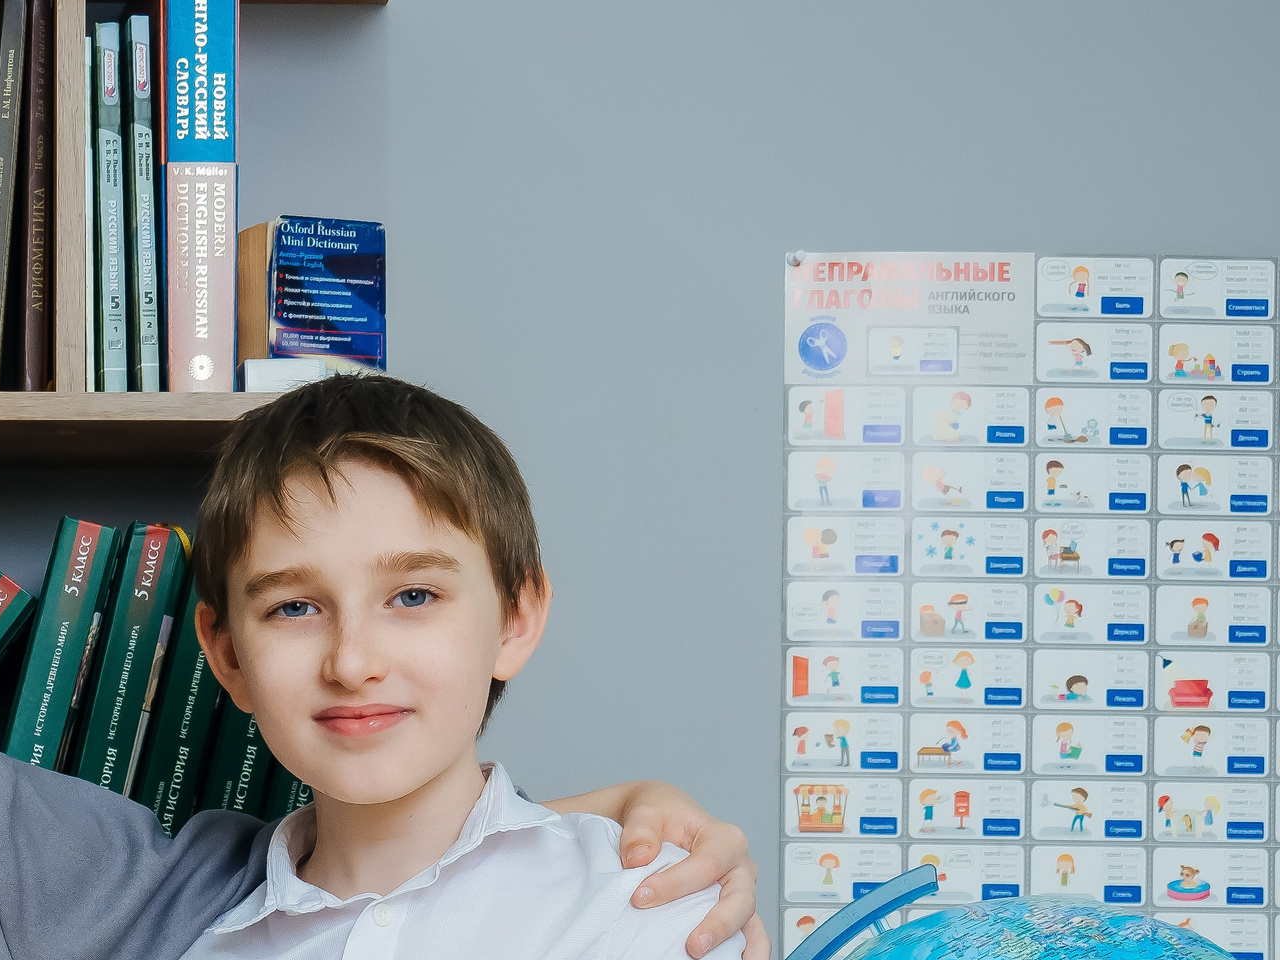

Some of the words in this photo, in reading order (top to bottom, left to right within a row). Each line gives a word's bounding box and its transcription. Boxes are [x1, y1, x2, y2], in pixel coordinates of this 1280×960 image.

[194, 0, 211, 140] НГЛО-РУССКИЙ
[176, 58, 189, 140] СЛОВАРЬ
[213, 73, 229, 141] НОВЫЙ
[108, 200, 120, 254] РУССКИЙ
[141, 194, 153, 248] РУССКИЙ
[214, 182, 225, 258] MODERN
[281, 223, 314, 234] Oxford
[317, 223, 356, 237] Russian
[28, 188, 44, 310] АРИФМЕТИКА
[195, 182, 208, 340] ENGLISH-RUSSIAN
[281, 235, 304, 247] Mini
[307, 237, 359, 253] Dictionary
[109, 258, 119, 292] ЯЗЫК
[142, 252, 152, 286] ЯЗЫК
[110, 296, 120, 310] 5
[144, 292, 153, 304] 5
[794, 289, 919, 310] ГЛАГОЛЫ
[928, 288, 1016, 302] АНГЛИЙСКОГО
[928, 304, 970, 315] ЯЗЫКА
[71, 535, 92, 582] КЛАСС
[141, 540, 161, 586] КЛАСС
[64, 584, 79, 597] 5
[134, 588, 149, 601] 5
[33, 692, 51, 736] ИСТОРИЯ
[45, 647, 62, 692] ДРЕВНЕГО
[56, 621, 70, 647] МИРА
[107, 696, 123, 740] ИСТОРИЯ
[118, 651, 133, 696] ДРЕВНЕГО
[128, 625, 140, 651] МИРА
[166, 746, 189, 810] ИСТОРИЯ
[179, 695, 195, 739] ИСТОРИЯ
[233, 745, 257, 809] ИСТОРИЯ
